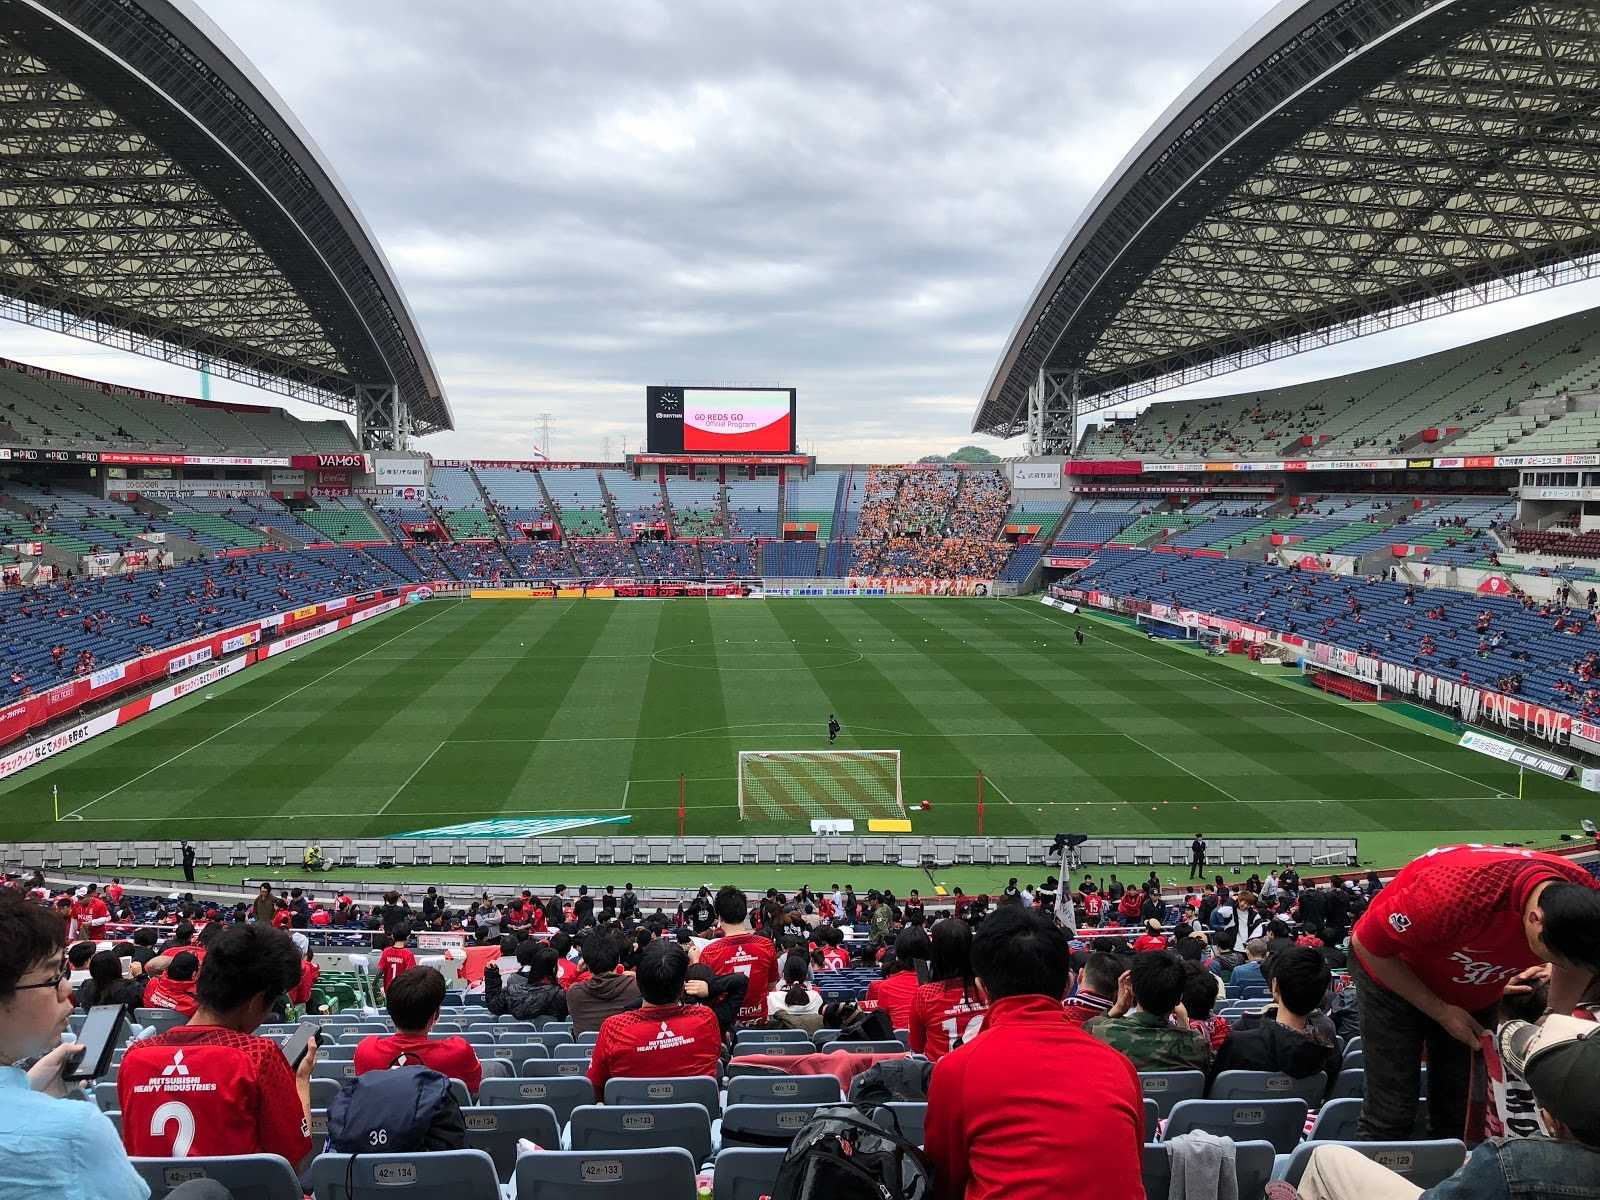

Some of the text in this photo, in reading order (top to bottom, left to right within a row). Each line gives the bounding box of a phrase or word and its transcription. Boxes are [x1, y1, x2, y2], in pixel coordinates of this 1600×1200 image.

[318, 456, 360, 467] VAMOS
[1483, 692, 1520, 730] ONE
[1521, 702, 1570, 746] LOVE
[636, 1037, 695, 1052] HEAVY INDUSTRIES
[648, 1035, 684, 1046] MITSUBISHI
[149, 1077, 201, 1086] MITSUBISHI
[133, 1083, 217, 1093] HEAVY INDUSTRIES
[370, 1129, 388, 1145] 36
